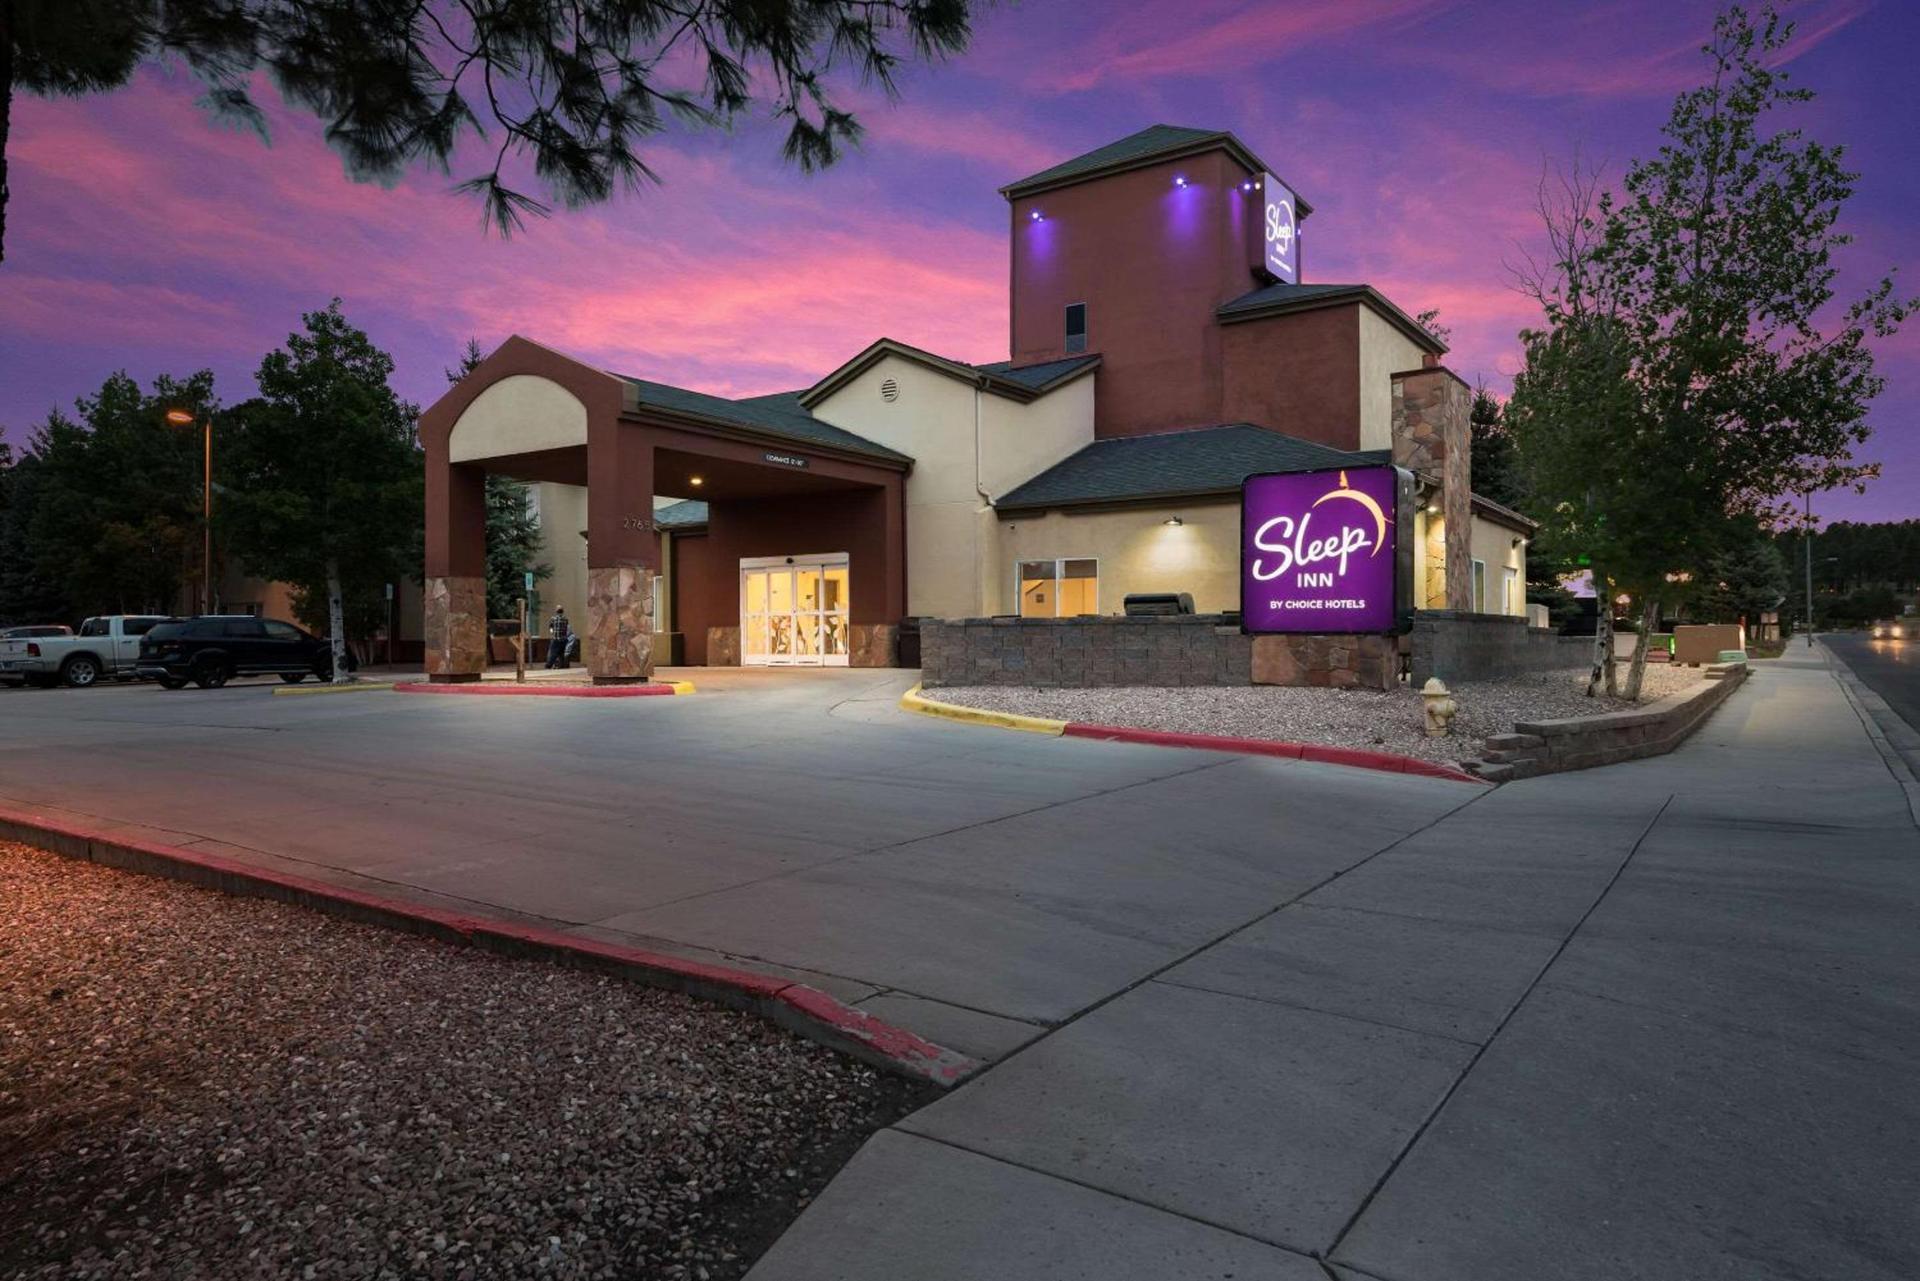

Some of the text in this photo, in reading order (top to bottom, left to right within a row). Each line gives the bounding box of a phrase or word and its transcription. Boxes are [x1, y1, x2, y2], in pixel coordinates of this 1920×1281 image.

[1252, 512, 1372, 581] Sleep
[1297, 572, 1333, 588] INN
[1270, 599, 1365, 609] BY CHOICE HOTELS
